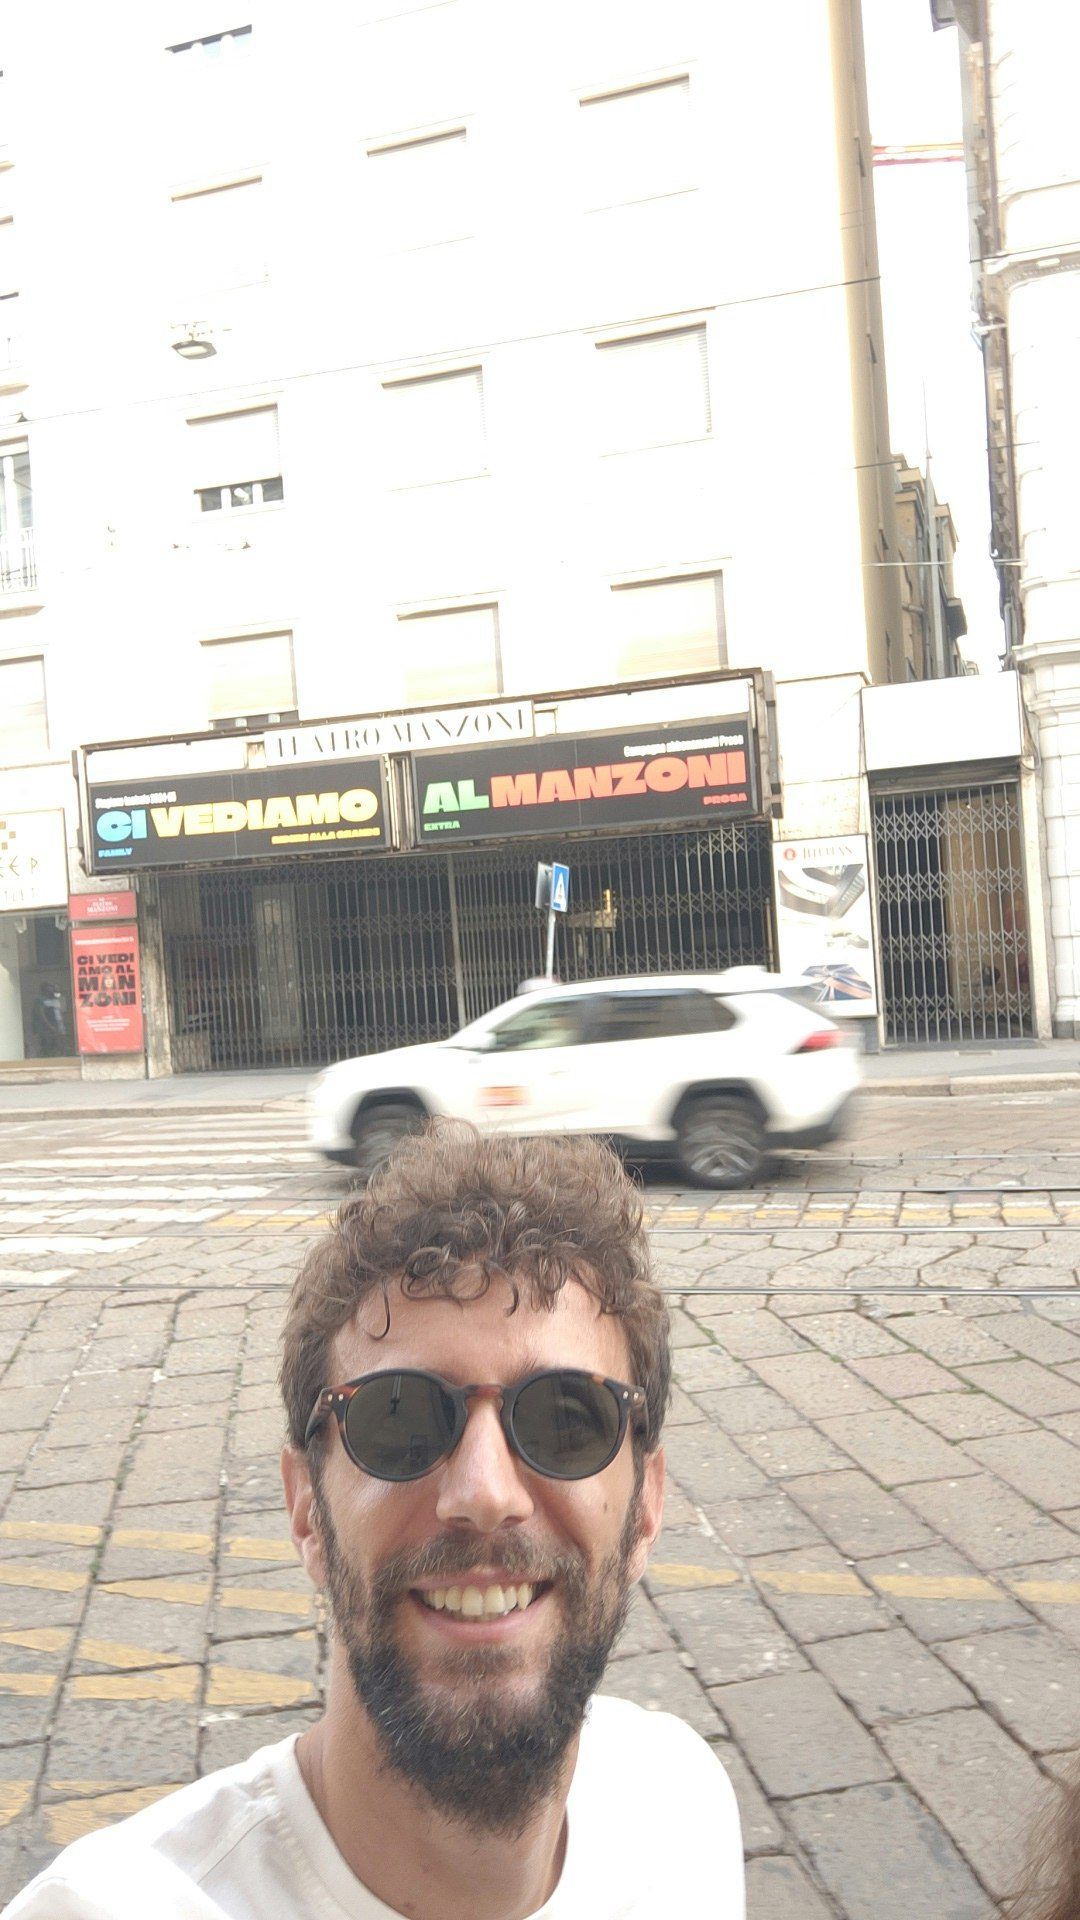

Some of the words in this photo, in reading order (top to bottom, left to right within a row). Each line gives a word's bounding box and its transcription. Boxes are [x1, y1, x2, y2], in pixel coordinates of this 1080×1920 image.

[422, 779, 490, 814] AL
[490, 750, 747, 808] MANZONI
[703, 792, 748, 806] PROSA
[96, 809, 148, 842] CI
[149, 788, 379, 838] VEDIAMO
[423, 820, 461, 832] EXTRA
[98, 847, 133, 858] FAMILY
[77, 955, 94, 965] CI
[96, 952, 135, 965] VEDI
[77, 965, 113, 976] AMO
[115, 964, 135, 975] AL
[77, 974, 137, 992] MAN
[79, 990, 137, 1008] ZONI
